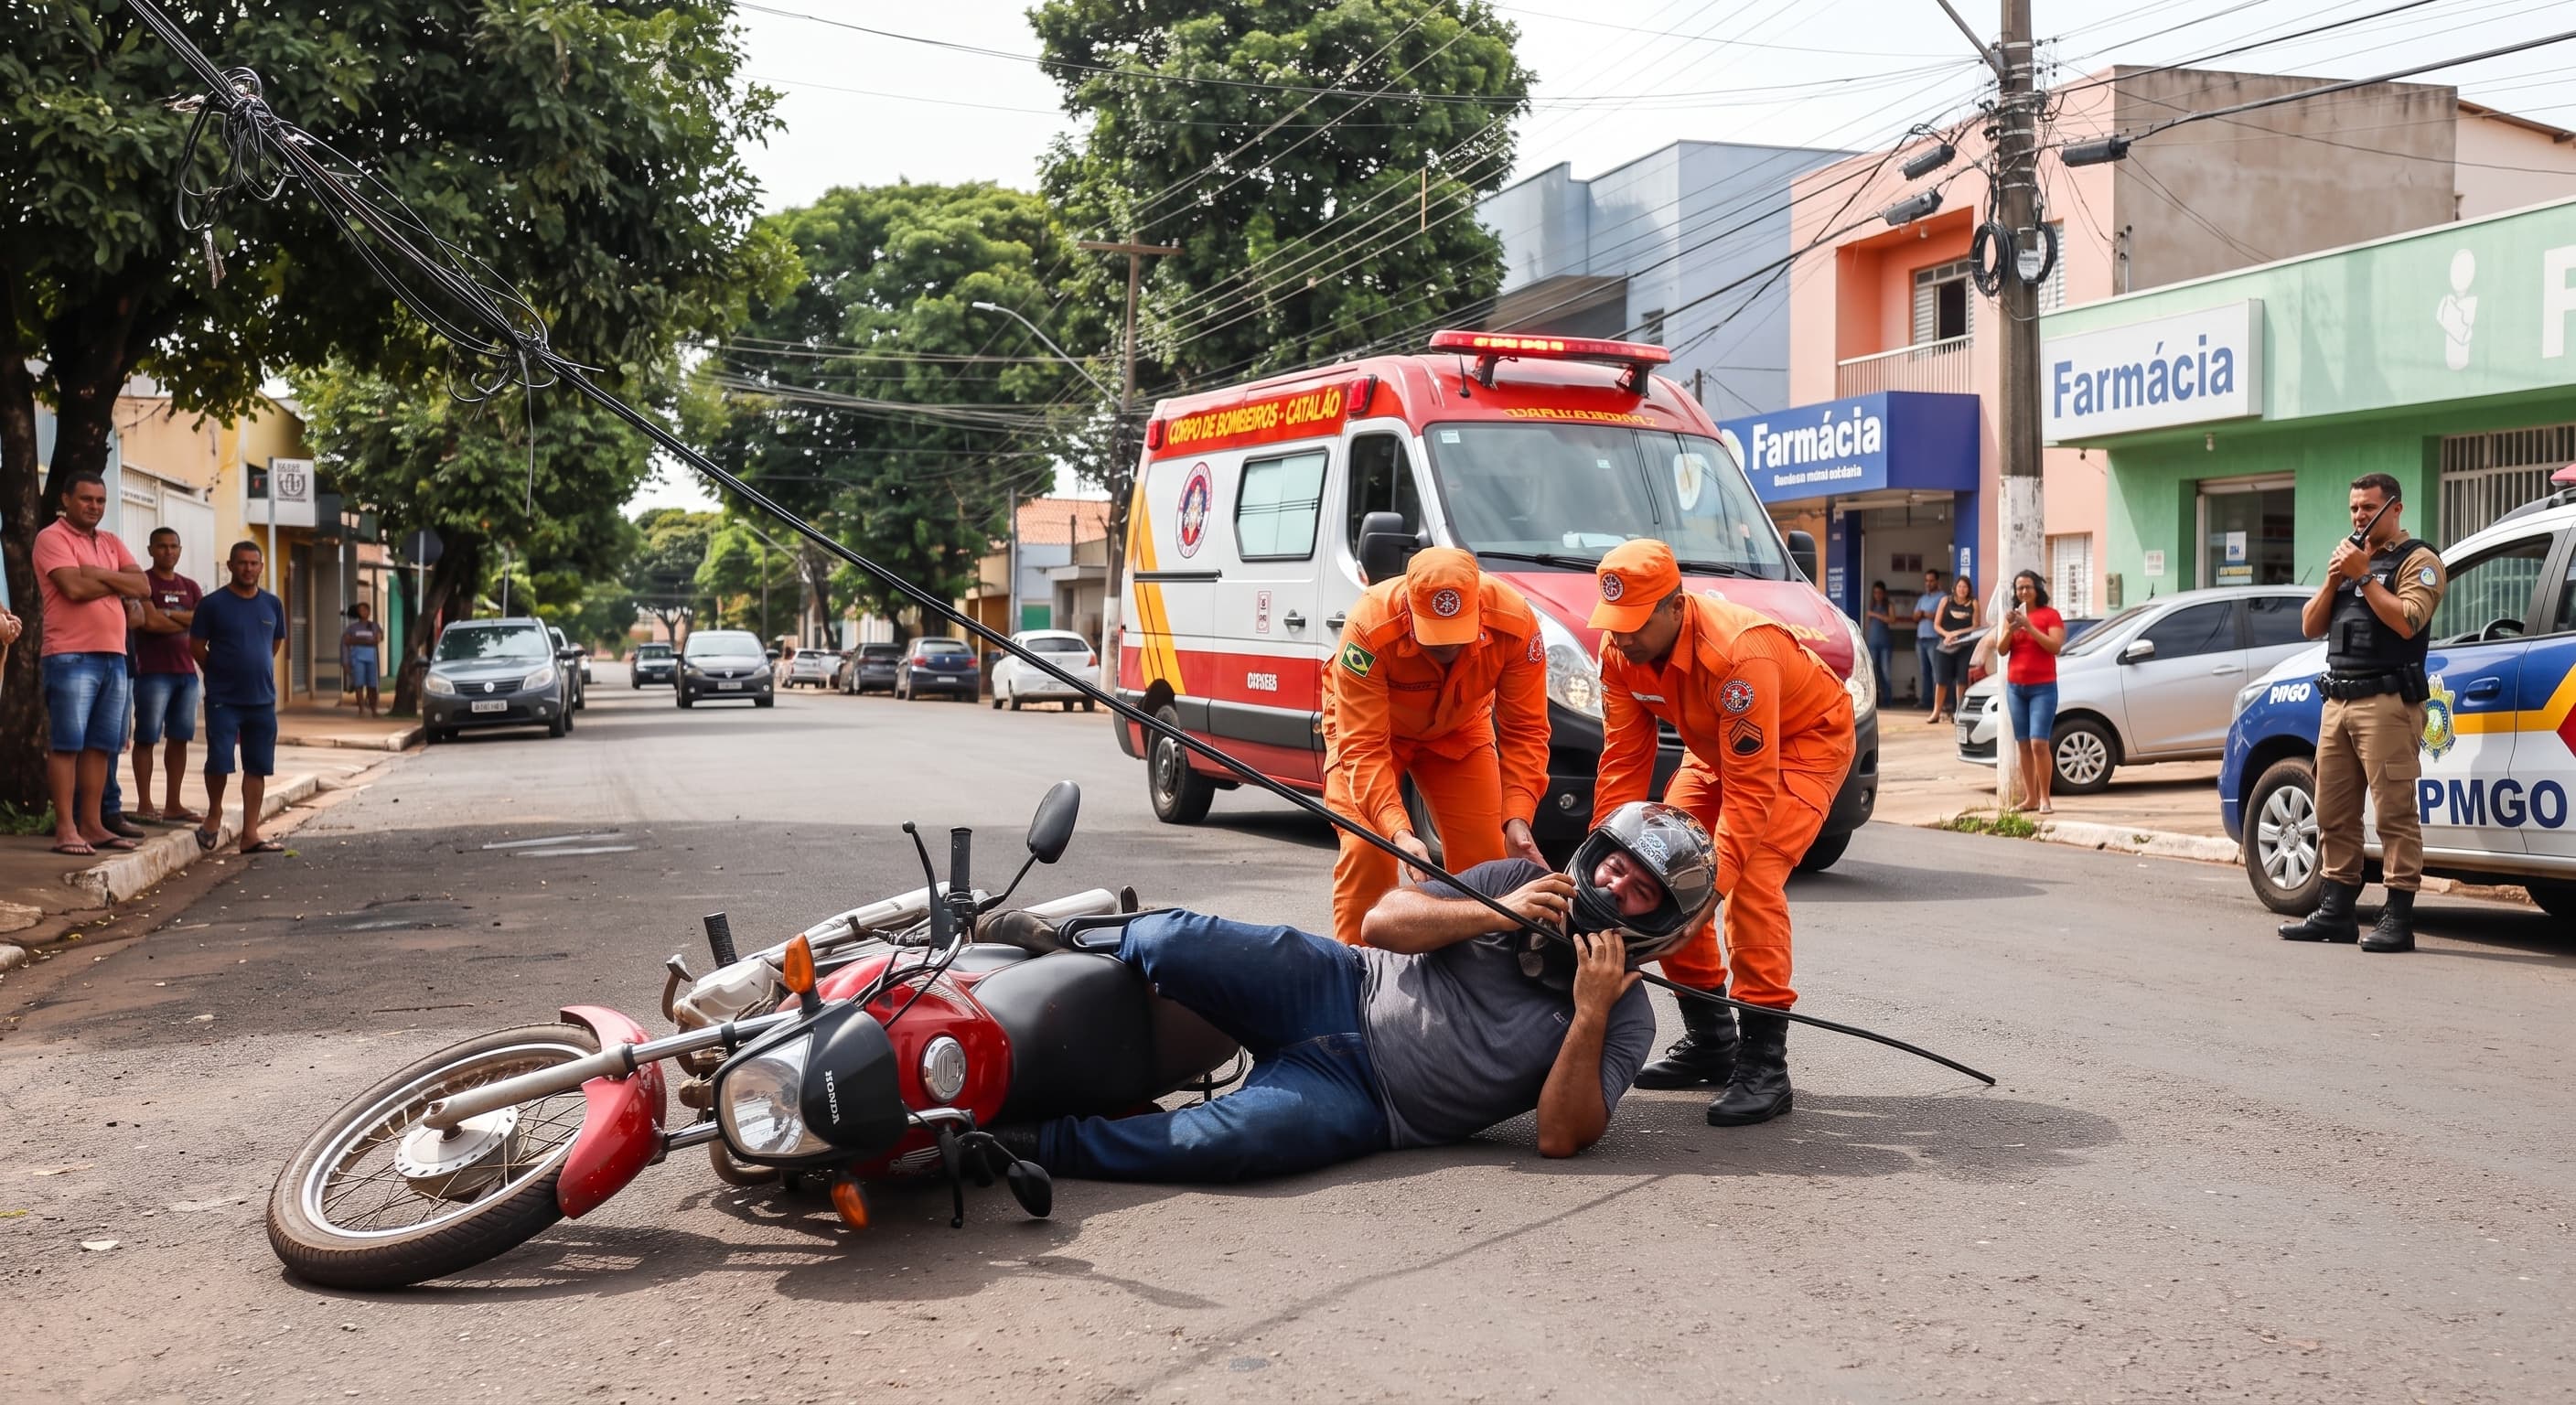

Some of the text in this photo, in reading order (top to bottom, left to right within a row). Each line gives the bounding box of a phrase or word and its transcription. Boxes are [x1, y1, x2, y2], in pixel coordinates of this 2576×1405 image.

[2054, 334, 2233, 419] Farmácia
[1169, 417, 1203, 445] CORPO
[1201, 413, 1217, 439] DE
[1216, 402, 1280, 437] BOMBEIROS
[1752, 406, 1882, 470] Farmácia
[2418, 778, 2568, 829] PMGO
[825, 1069, 840, 1125] HONDA
